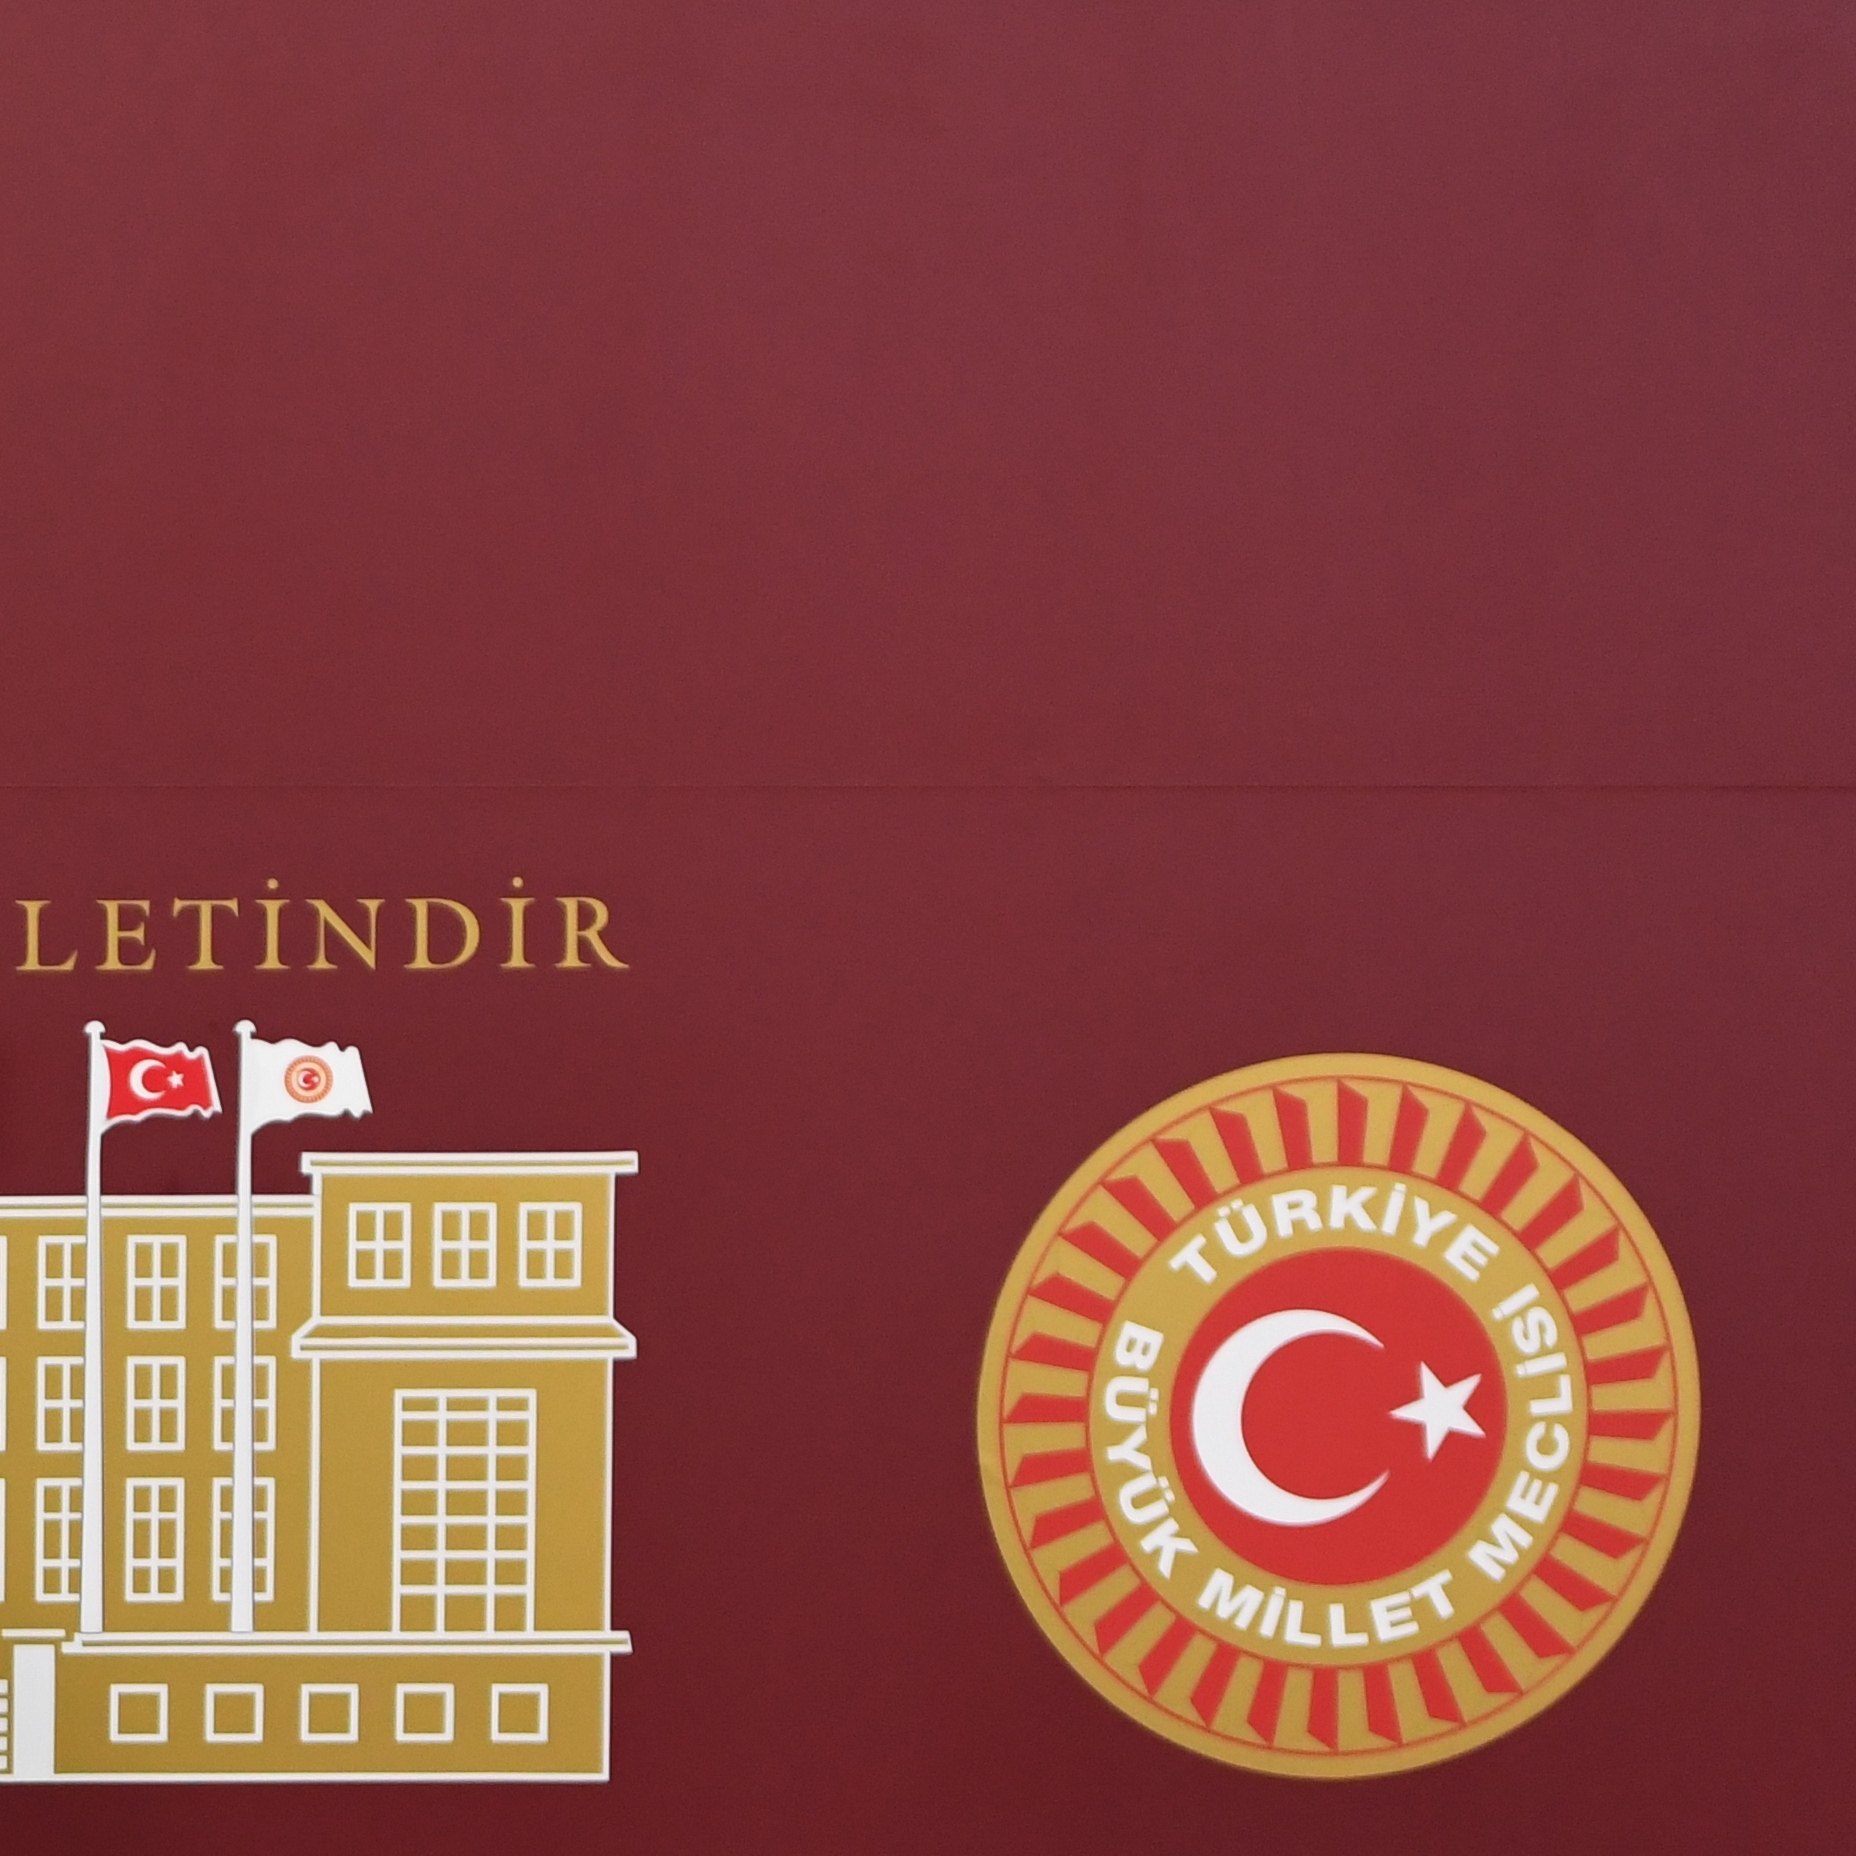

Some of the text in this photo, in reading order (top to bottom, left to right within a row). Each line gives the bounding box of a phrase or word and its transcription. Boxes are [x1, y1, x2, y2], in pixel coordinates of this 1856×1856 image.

[1102, 1182, 1574, 1649] TÜRKİYE BÜYÜK MİLLET MECLİSİ
